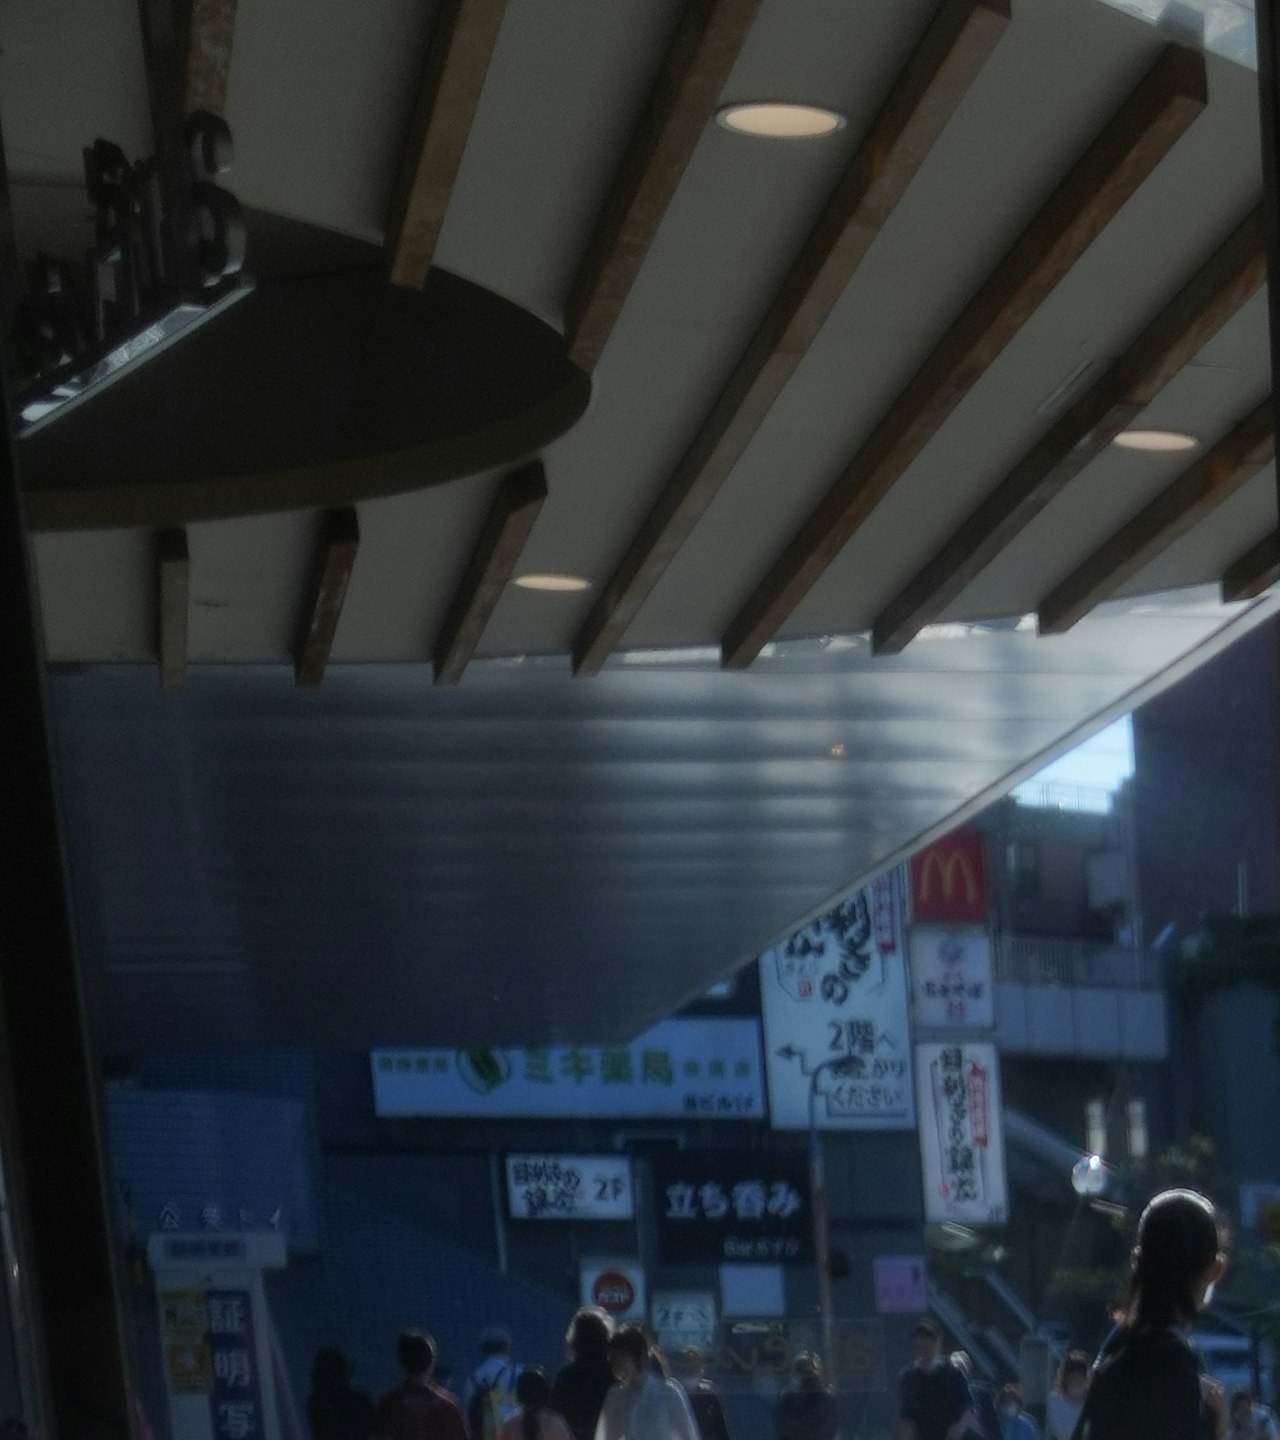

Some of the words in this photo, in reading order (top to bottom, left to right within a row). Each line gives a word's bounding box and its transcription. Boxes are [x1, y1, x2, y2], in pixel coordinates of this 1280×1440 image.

[593, 1178, 624, 1202] 2F
[664, 1180, 802, 1219] 立ち呑み
